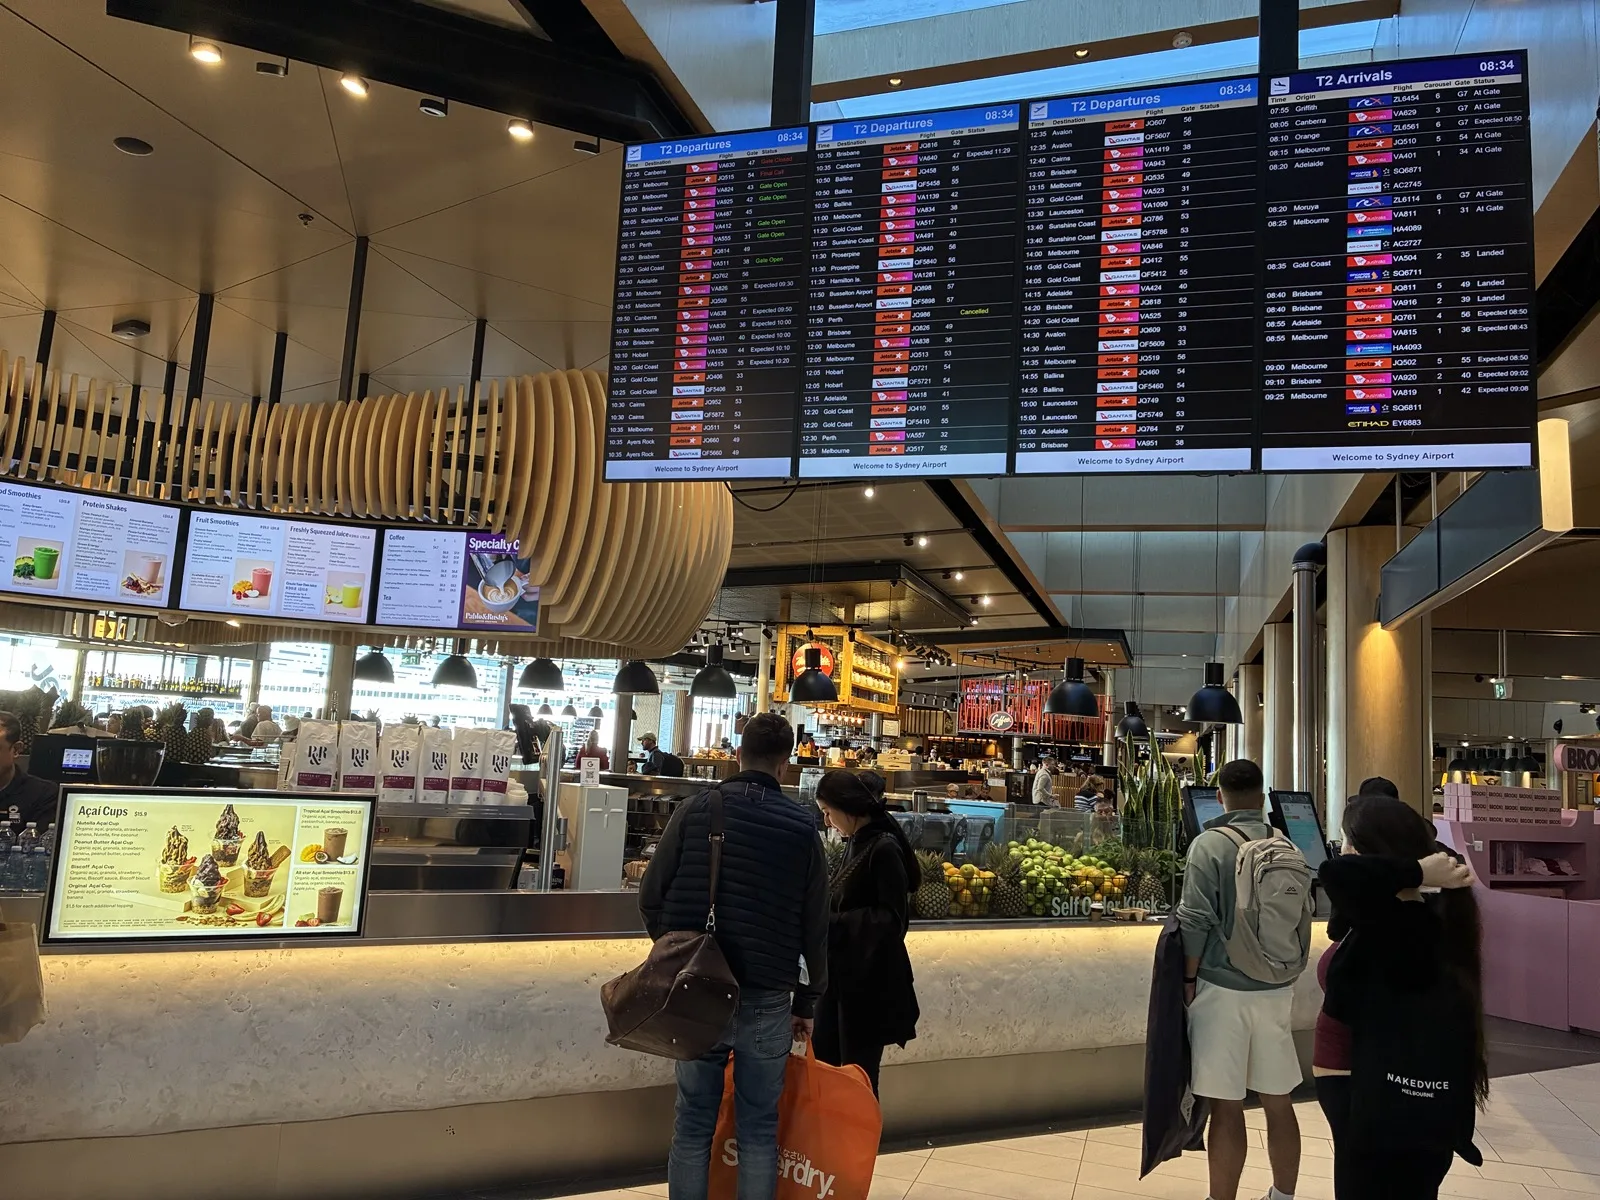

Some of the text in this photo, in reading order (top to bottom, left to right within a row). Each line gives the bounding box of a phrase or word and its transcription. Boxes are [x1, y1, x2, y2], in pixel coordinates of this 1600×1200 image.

[1480, 60, 1514, 71] 08:34
[1316, 70, 1392, 86] T2 Arrivals
[1220, 84, 1251, 95] 08:34
[1071, 94, 1160, 112] T2 Departures
[985, 109, 1013, 120] 08:34
[854, 119, 933, 134] T2 Departures
[1053, 117, 1085, 125] Destination
[778, 132, 803, 142] 08:34
[660, 140, 731, 155] T2 Departures
[1294, 146, 1330, 154] Melbourne
[966, 149, 993, 158] Expected
[960, 307, 989, 316] Cancelled
[922, 461, 947, 469] Airport
[1125, 457, 1154, 465] Sydney
[1156, 456, 1184, 465] Airport
[8, 489, 41, 499] Smoothies
[82, 500, 128, 513] Protein Shakes
[210, 518, 239, 527] Smoothies
[290, 526, 309, 535] Freshly
[310, 528, 335, 537] Squeezed
[469, 537, 512, 552] Specialty
[1568, 748, 1600, 770] BRO
[78, 806, 102, 818] Açaí
[103, 806, 128, 818] Cups
[1051, 896, 1080, 916] Self
[1123, 895, 1158, 914] Kiosk
[1387, 1072, 1449, 1090] NAKEDVICE
[1401, 1088, 1434, 1098] MELBOURNE
